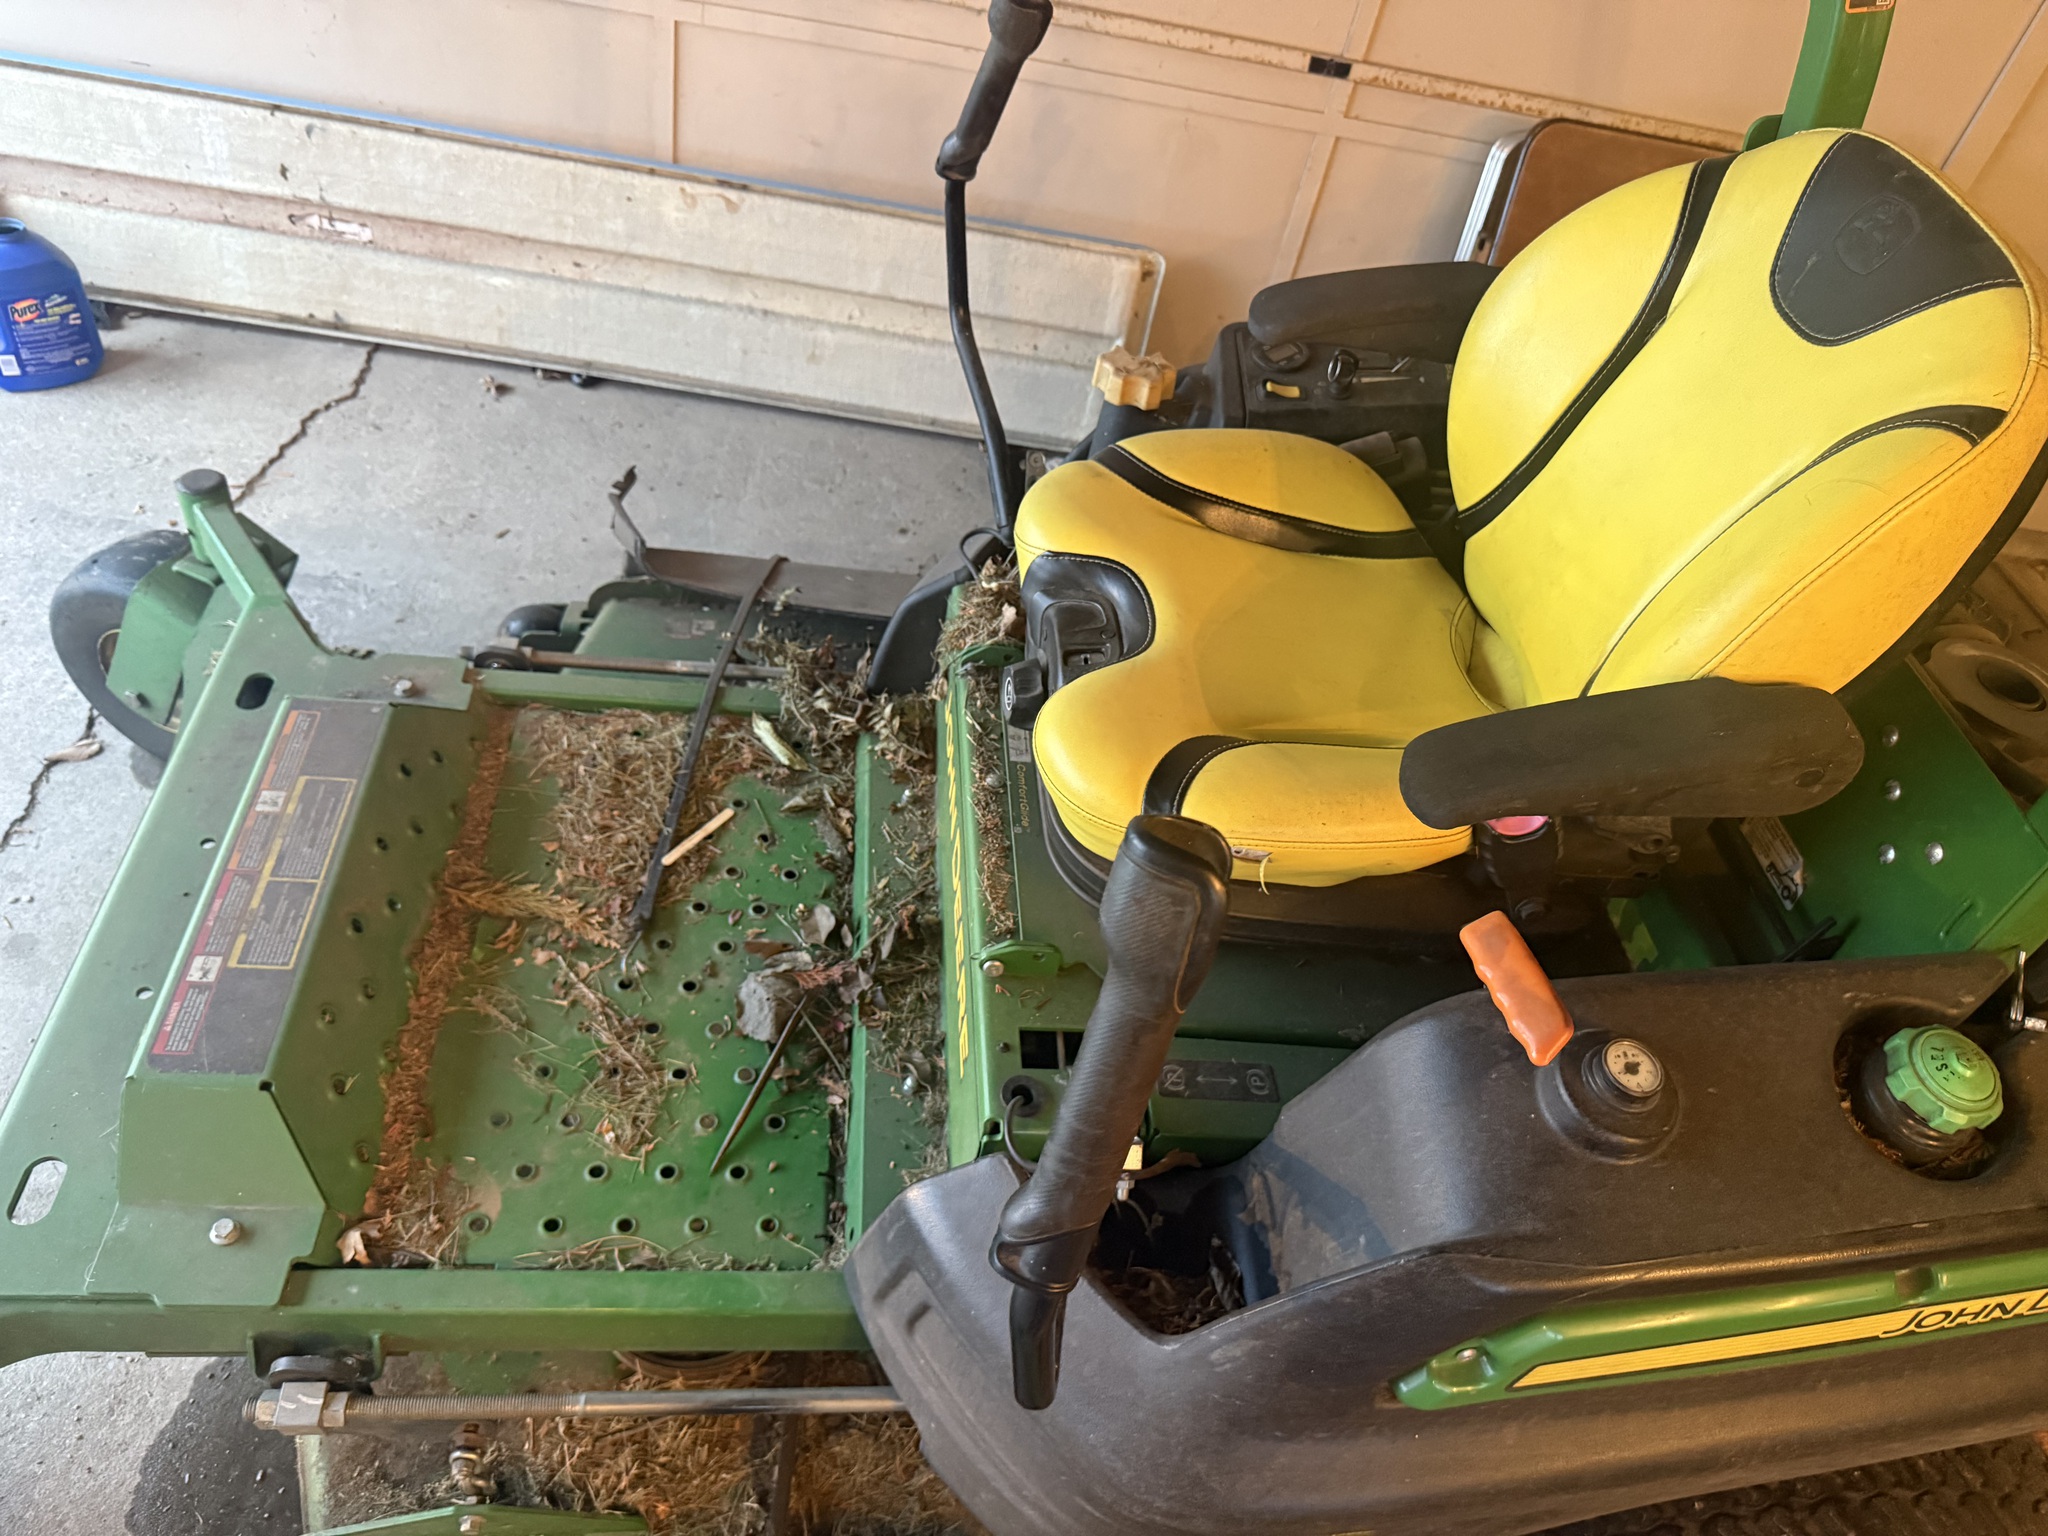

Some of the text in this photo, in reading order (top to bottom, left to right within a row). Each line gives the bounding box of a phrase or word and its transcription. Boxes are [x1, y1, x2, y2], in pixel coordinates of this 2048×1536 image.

[9, 303, 41, 319] Purex
[1016, 763, 1030, 828] ComfortGlide
[1881, 1298, 2027, 1336] JOHN
